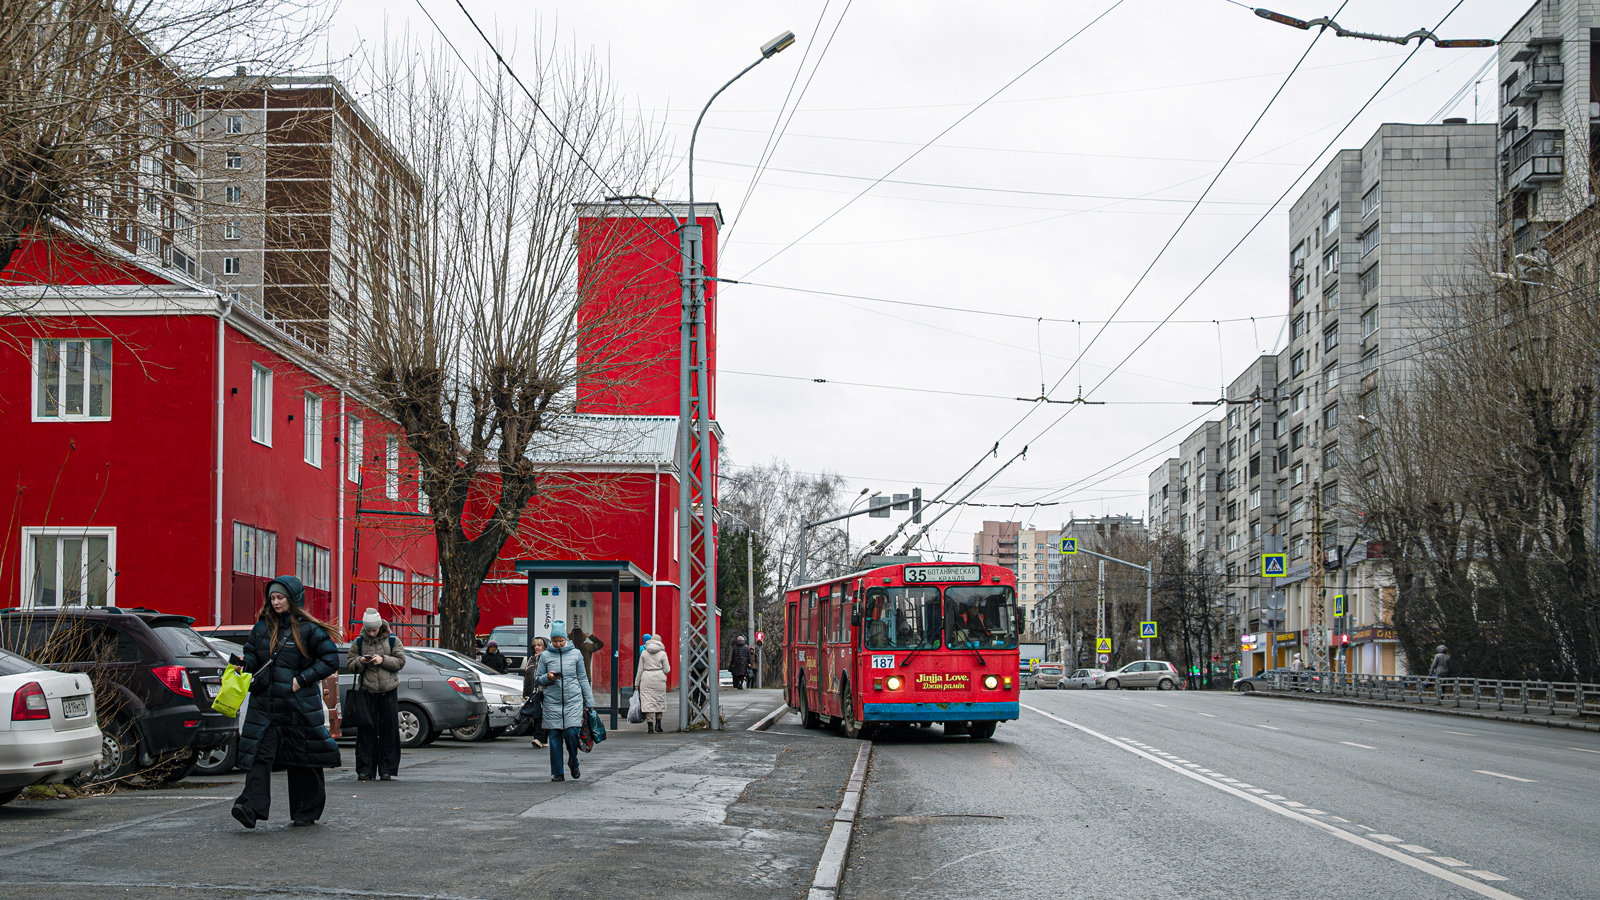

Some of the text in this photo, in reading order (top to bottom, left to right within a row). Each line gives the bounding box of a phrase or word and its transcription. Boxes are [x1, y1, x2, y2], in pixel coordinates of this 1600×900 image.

[908, 569, 927, 582] 35
[873, 658, 894, 668] 187
[916, 673, 970, 683] Jinjja Love,
[922, 682, 943, 690] Джин
